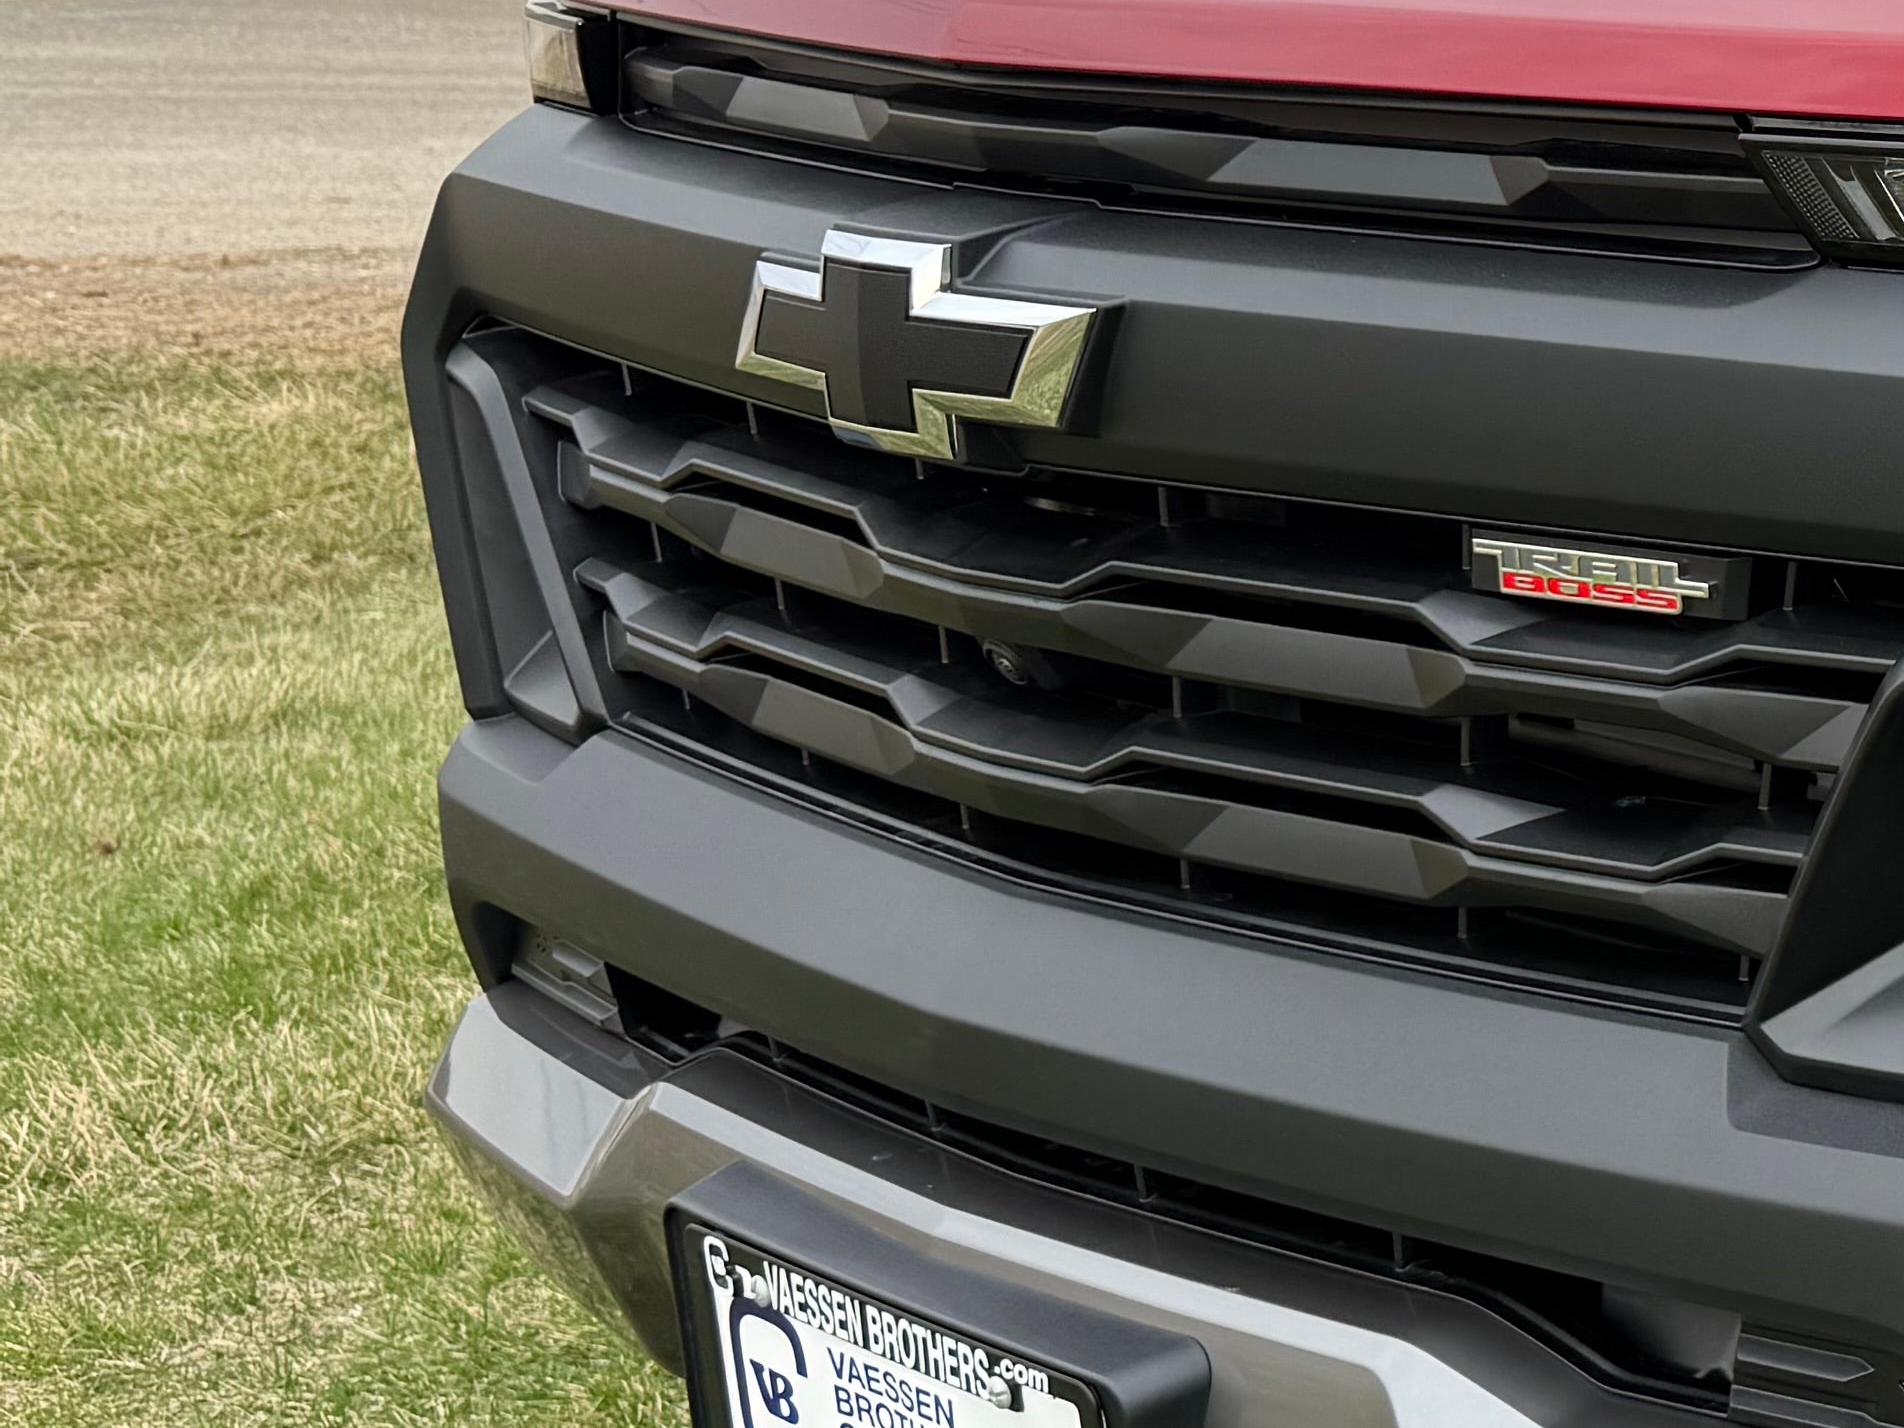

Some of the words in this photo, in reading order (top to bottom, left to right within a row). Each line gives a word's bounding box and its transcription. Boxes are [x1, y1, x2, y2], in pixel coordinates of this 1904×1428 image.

[1472, 538, 1709, 598] TRAIL
[1501, 571, 1683, 614] BOSS
[763, 1260, 864, 1348] VAESSEN
